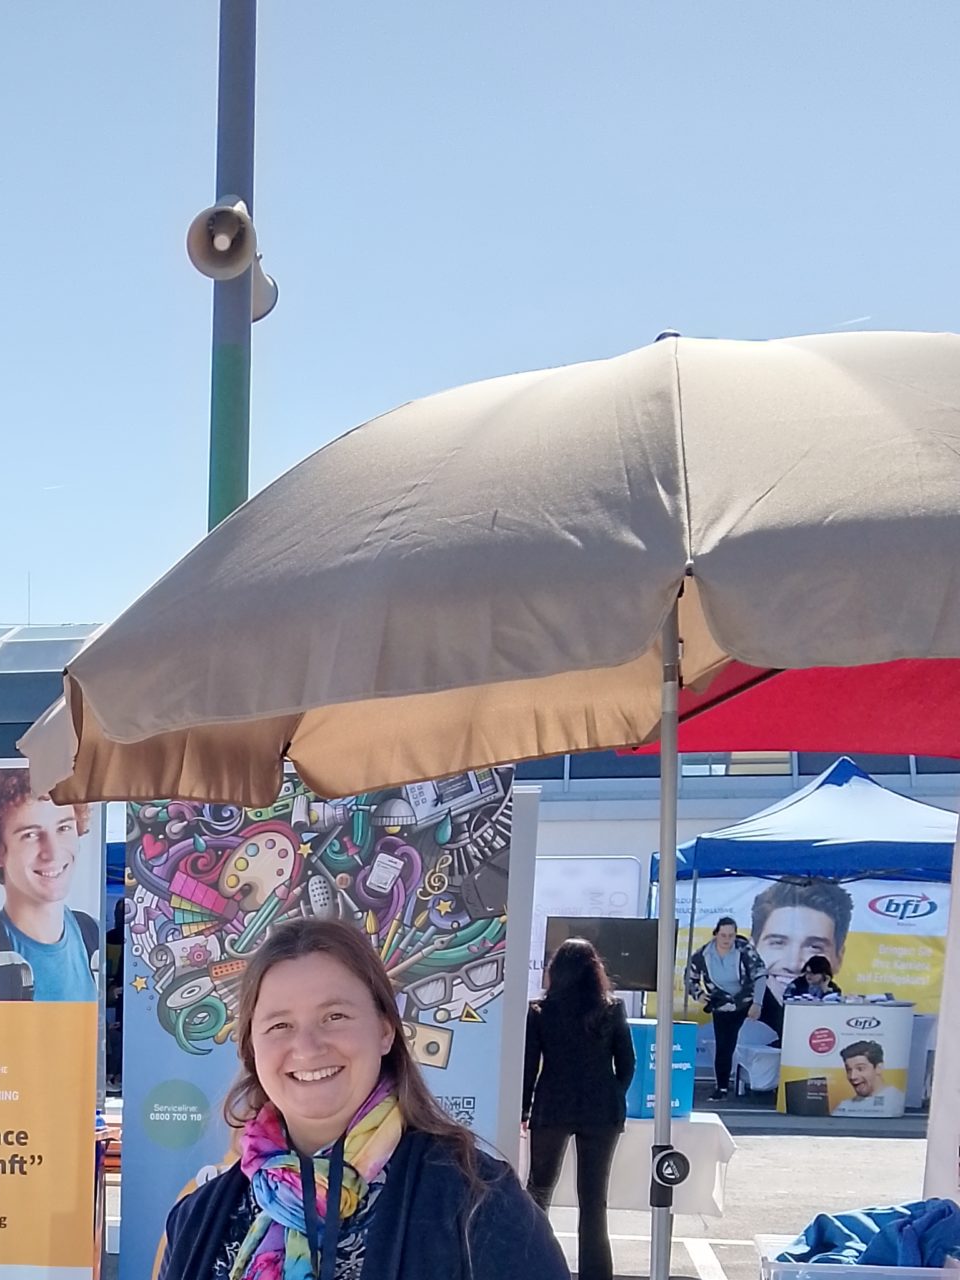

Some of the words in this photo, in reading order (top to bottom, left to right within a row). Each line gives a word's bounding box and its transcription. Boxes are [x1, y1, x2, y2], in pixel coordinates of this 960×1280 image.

[885, 898, 921, 920] bfi
[855, 1020, 873, 1030] bfi
[153, 1103, 198, 1112] Serviceline:
[149, 1113, 170, 1121] 0800
[172, 1113, 188, 1121] 700
